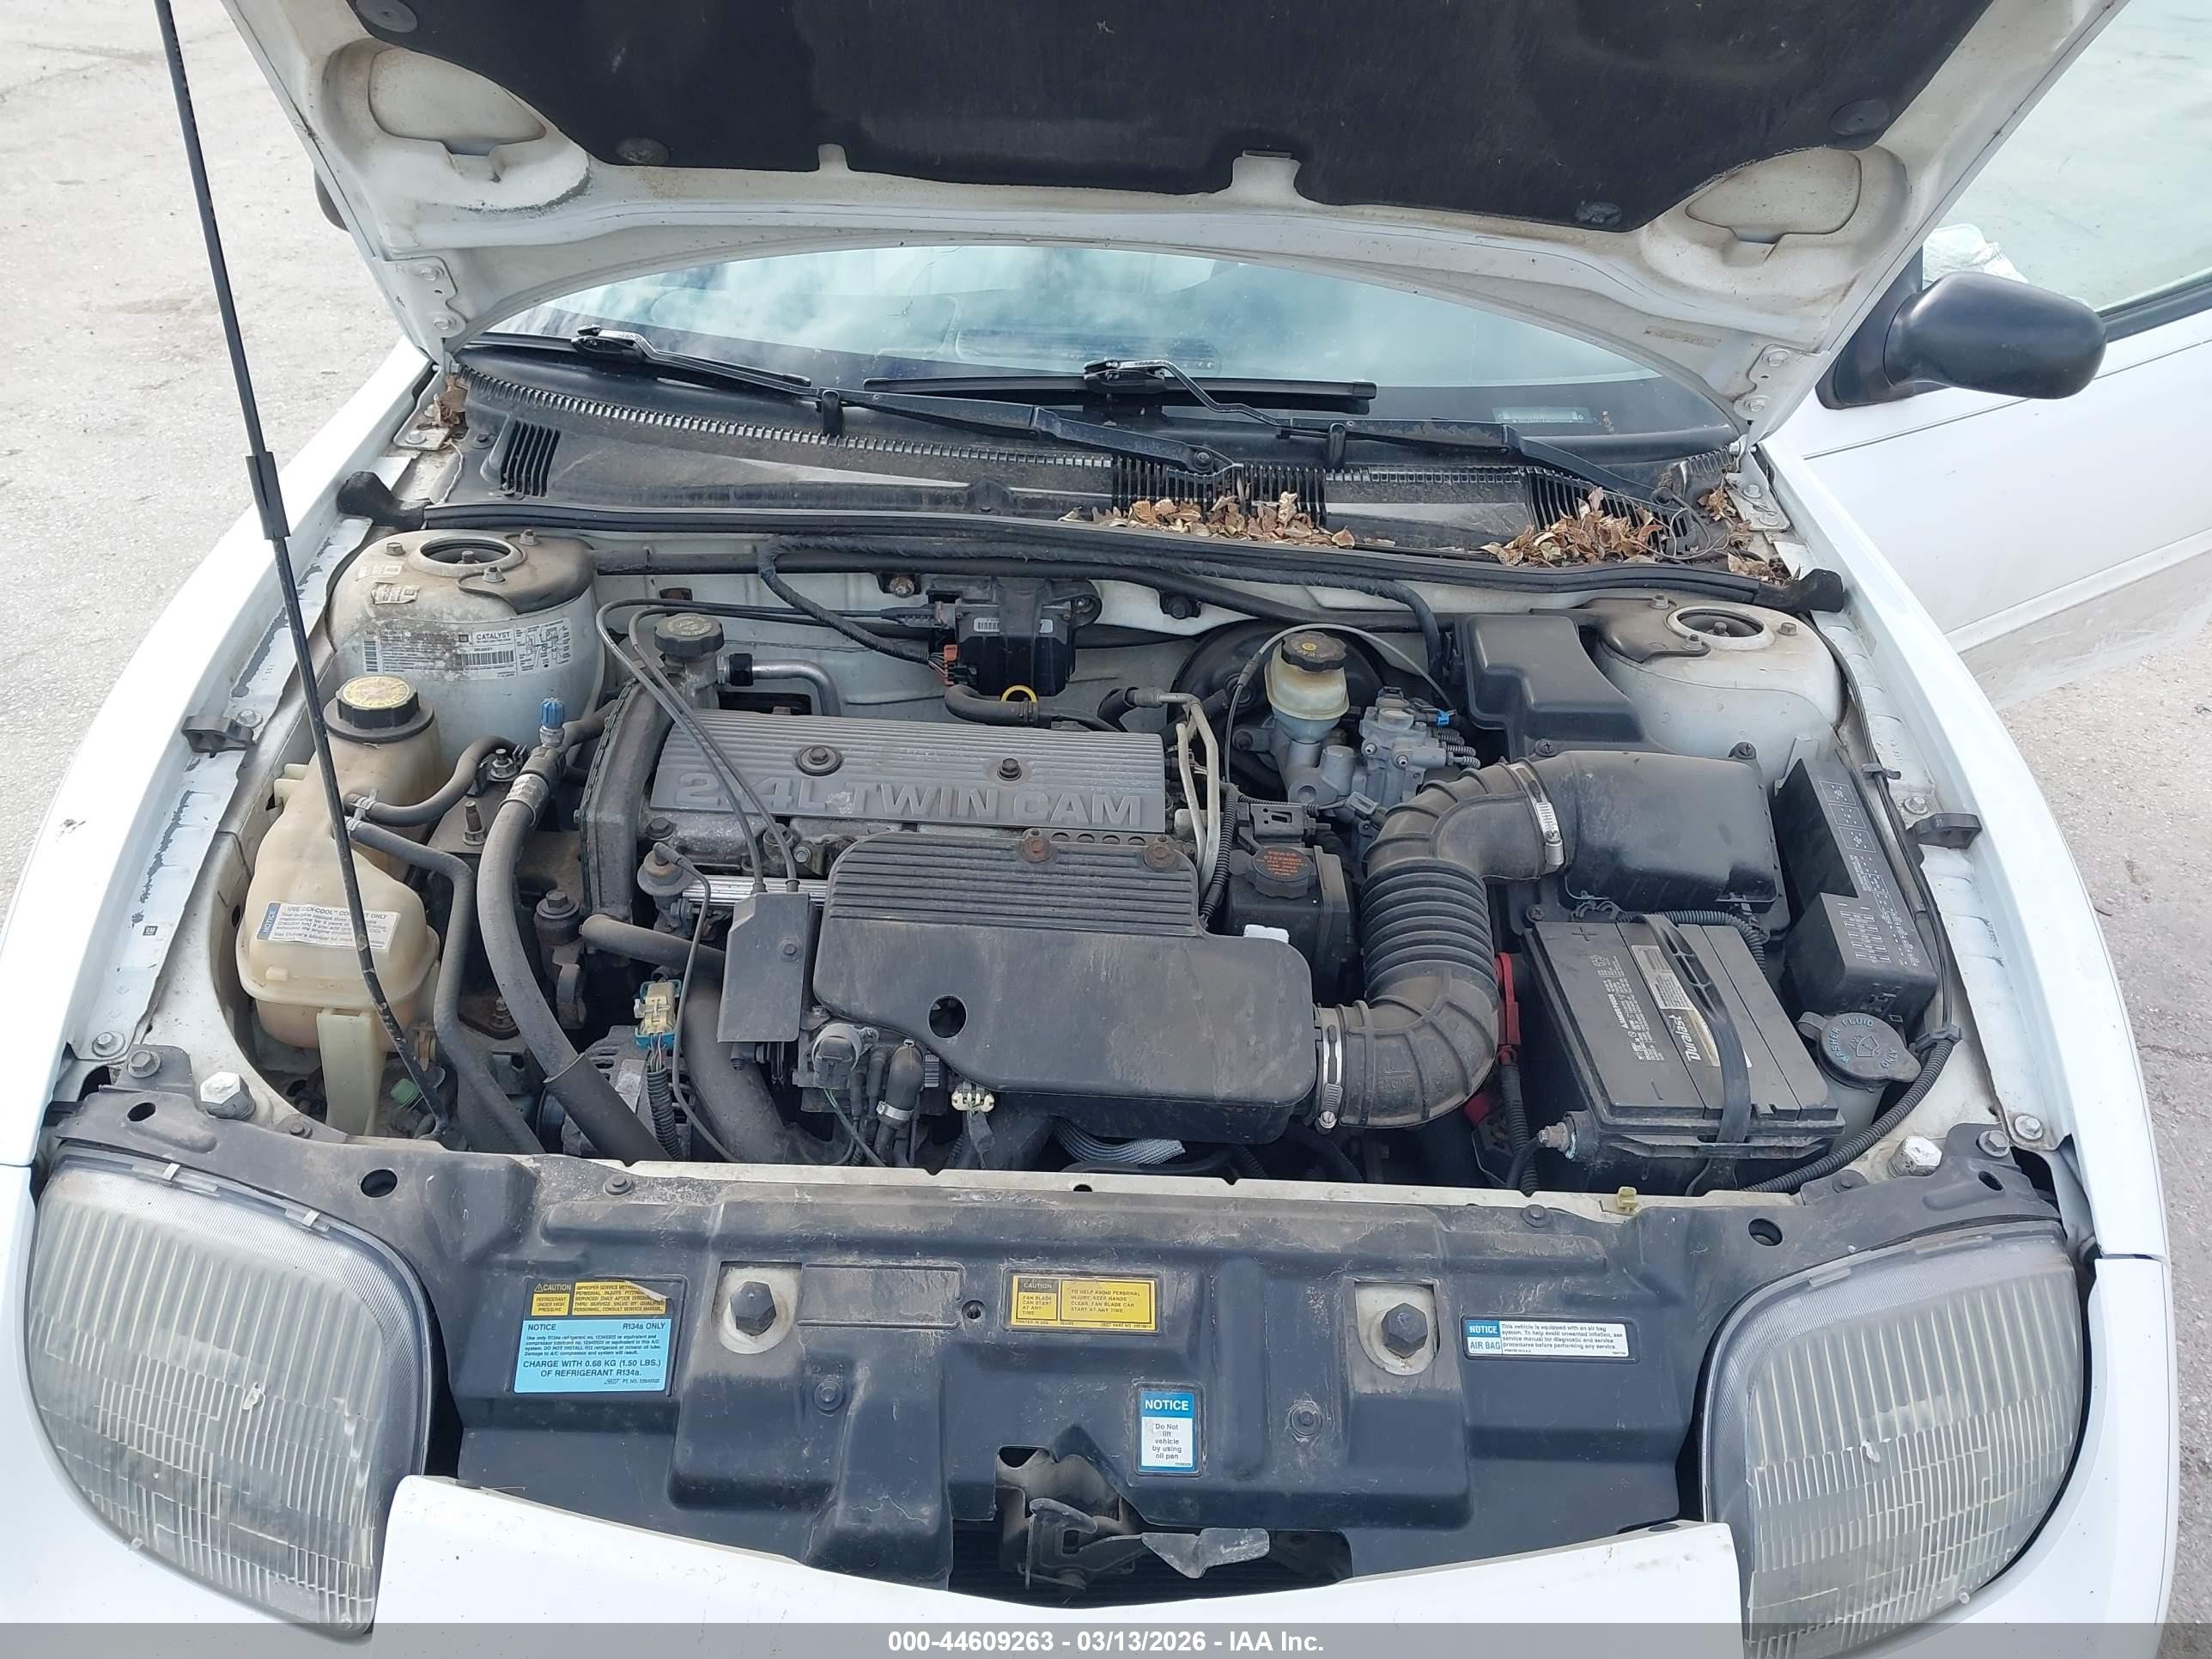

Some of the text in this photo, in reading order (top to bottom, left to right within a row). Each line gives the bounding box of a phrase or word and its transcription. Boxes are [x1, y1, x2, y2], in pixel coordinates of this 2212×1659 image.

[477, 632, 510, 640] CATALYST
[844, 781, 1001, 818] TWIN
[1012, 789, 1142, 826] CAM
[1668, 1014, 1702, 1061] Duralast
[1829, 1017, 1899, 1069] WASHER FLUID ONLY
[1469, 1325, 1498, 1334] NOTICE
[1470, 1341, 1501, 1350] AIR BAG
[523, 1360, 559, 1368] CHARGE
[619, 1359, 638, 1367] (1.50
[640, 1359, 661, 1367] LBS.)
[554, 1369, 614, 1377] REFRIGERANT
[1145, 1399, 1189, 1411] NOTICE
